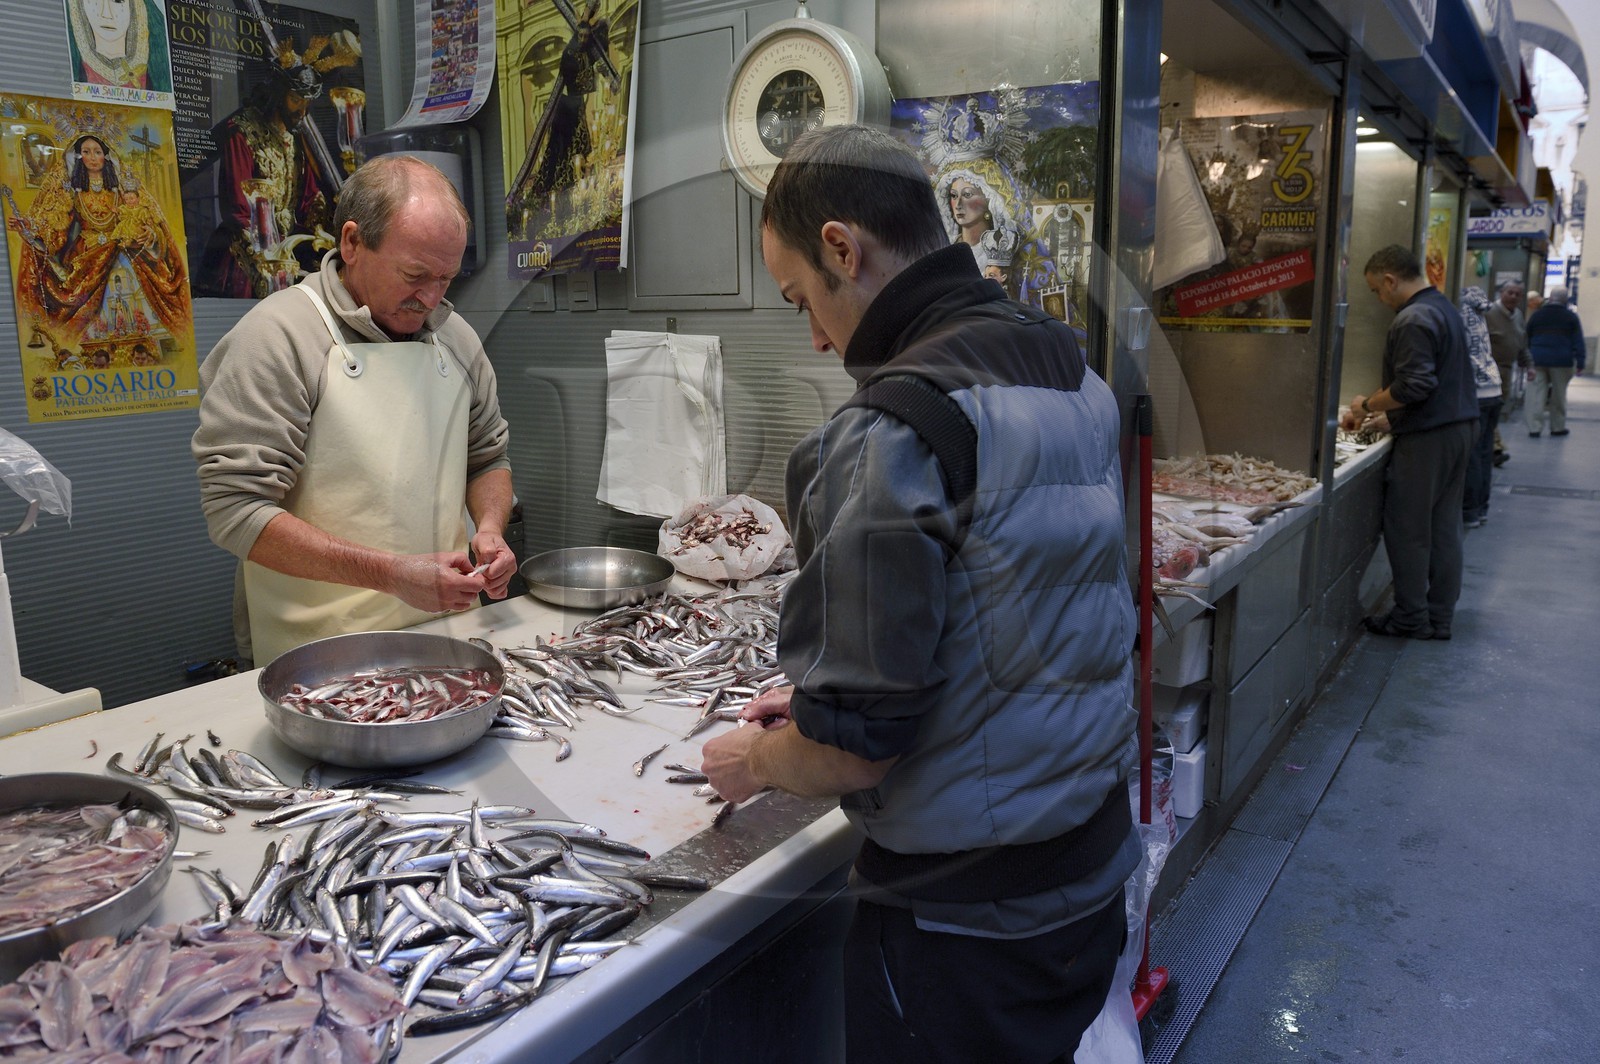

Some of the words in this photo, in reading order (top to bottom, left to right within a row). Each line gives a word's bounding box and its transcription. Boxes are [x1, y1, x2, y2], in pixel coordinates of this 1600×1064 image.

[170, 4, 236, 32] SEÑOR
[240, 20, 262, 38] DE
[273, 15, 305, 29] MUSICALES
[172, 23, 206, 45] LOS
[211, 31, 264, 56] PASOS
[173, 65, 195, 75] DULCE
[196, 70, 223, 80] NOMBRE
[184, 76, 202, 85] JESÚS
[74, 83, 100, 95] SMANA
[174, 92, 191, 100] VERA
[192, 94, 211, 103] CRUZ
[176, 100, 207, 108] CAMPILLOS)
[176, 108, 210, 119] SENTENCIA
[1272, 125, 1314, 203] 75
[1262, 212, 1315, 226] CARMEN
[1467, 219, 1504, 233] ARDO
[1180, 278, 1227, 301] EXPOSICIÓN
[1227, 269, 1262, 287] PALACIO
[1262, 254, 1306, 275] EPISCOPAL
[1195, 299, 1207, 308] Del
[1214, 295, 1220, 303] al
[1230, 289, 1239, 297] de
[1239, 280, 1268, 294] Octubre
[1268, 277, 1277, 286] de
[1278, 271, 1295, 283] 2013
[51, 369, 176, 398] ROSARIO
[55, 394, 112, 408] PATRONA
[115, 392, 130, 403] DE
[133, 391, 145, 401] EL
[149, 389, 177, 400] PALO
[64, 408, 101, 416] PROCESIONAL
